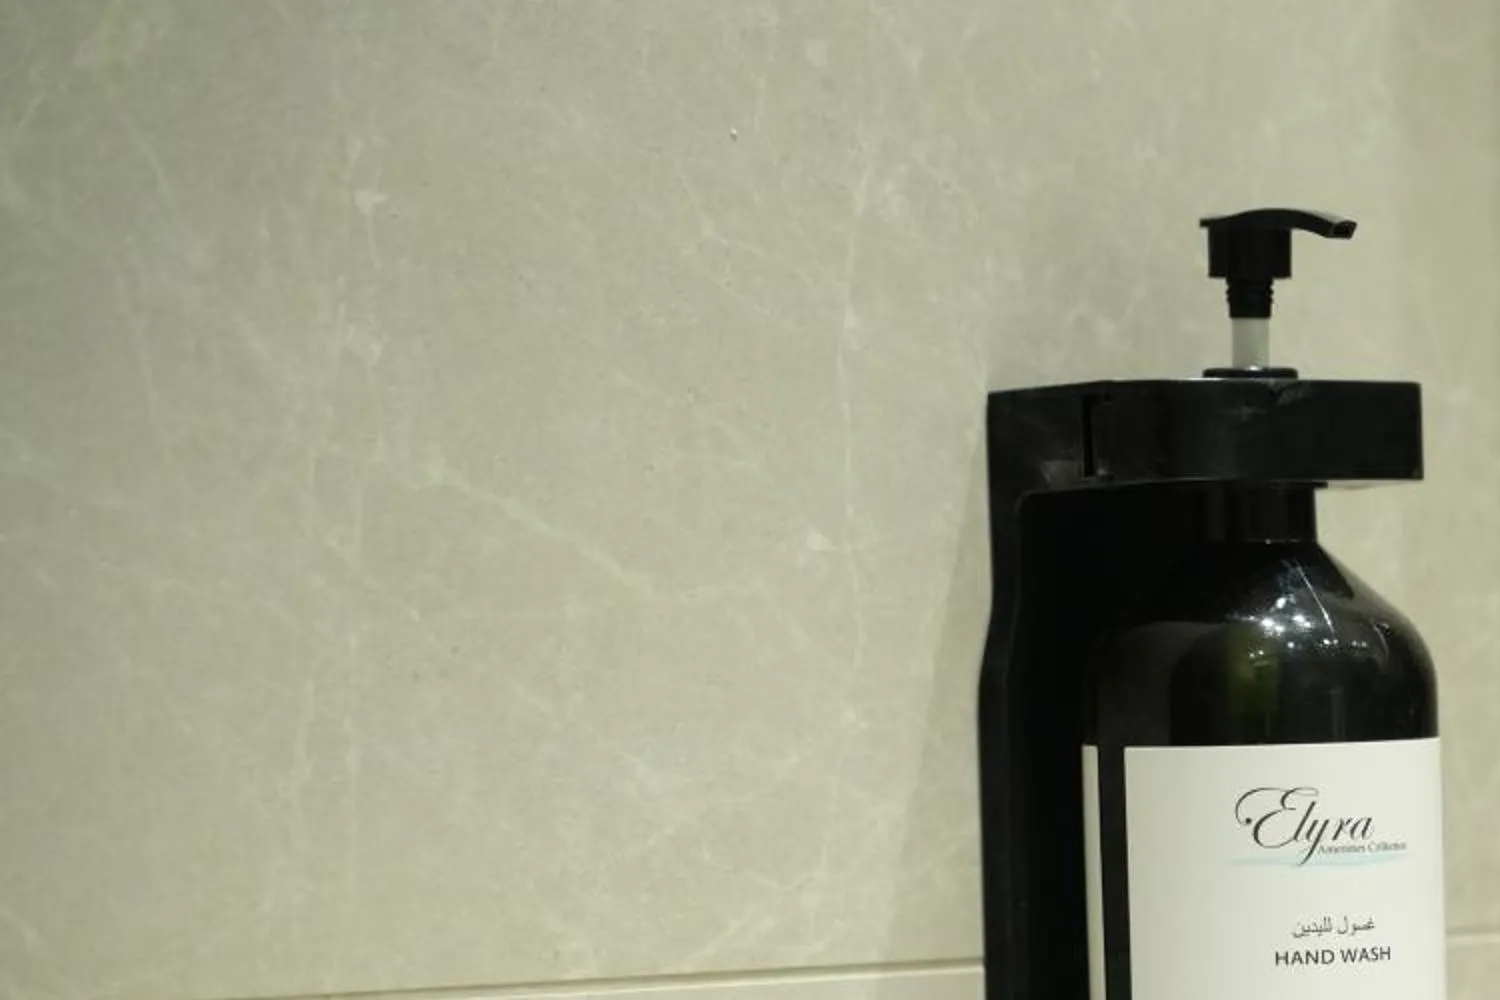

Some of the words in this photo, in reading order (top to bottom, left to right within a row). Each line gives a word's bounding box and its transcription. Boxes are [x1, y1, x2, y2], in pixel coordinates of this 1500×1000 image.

[1234, 786, 1373, 867] Elyra
[1274, 949, 1335, 966] HAND
[1340, 945, 1391, 963] WASH
